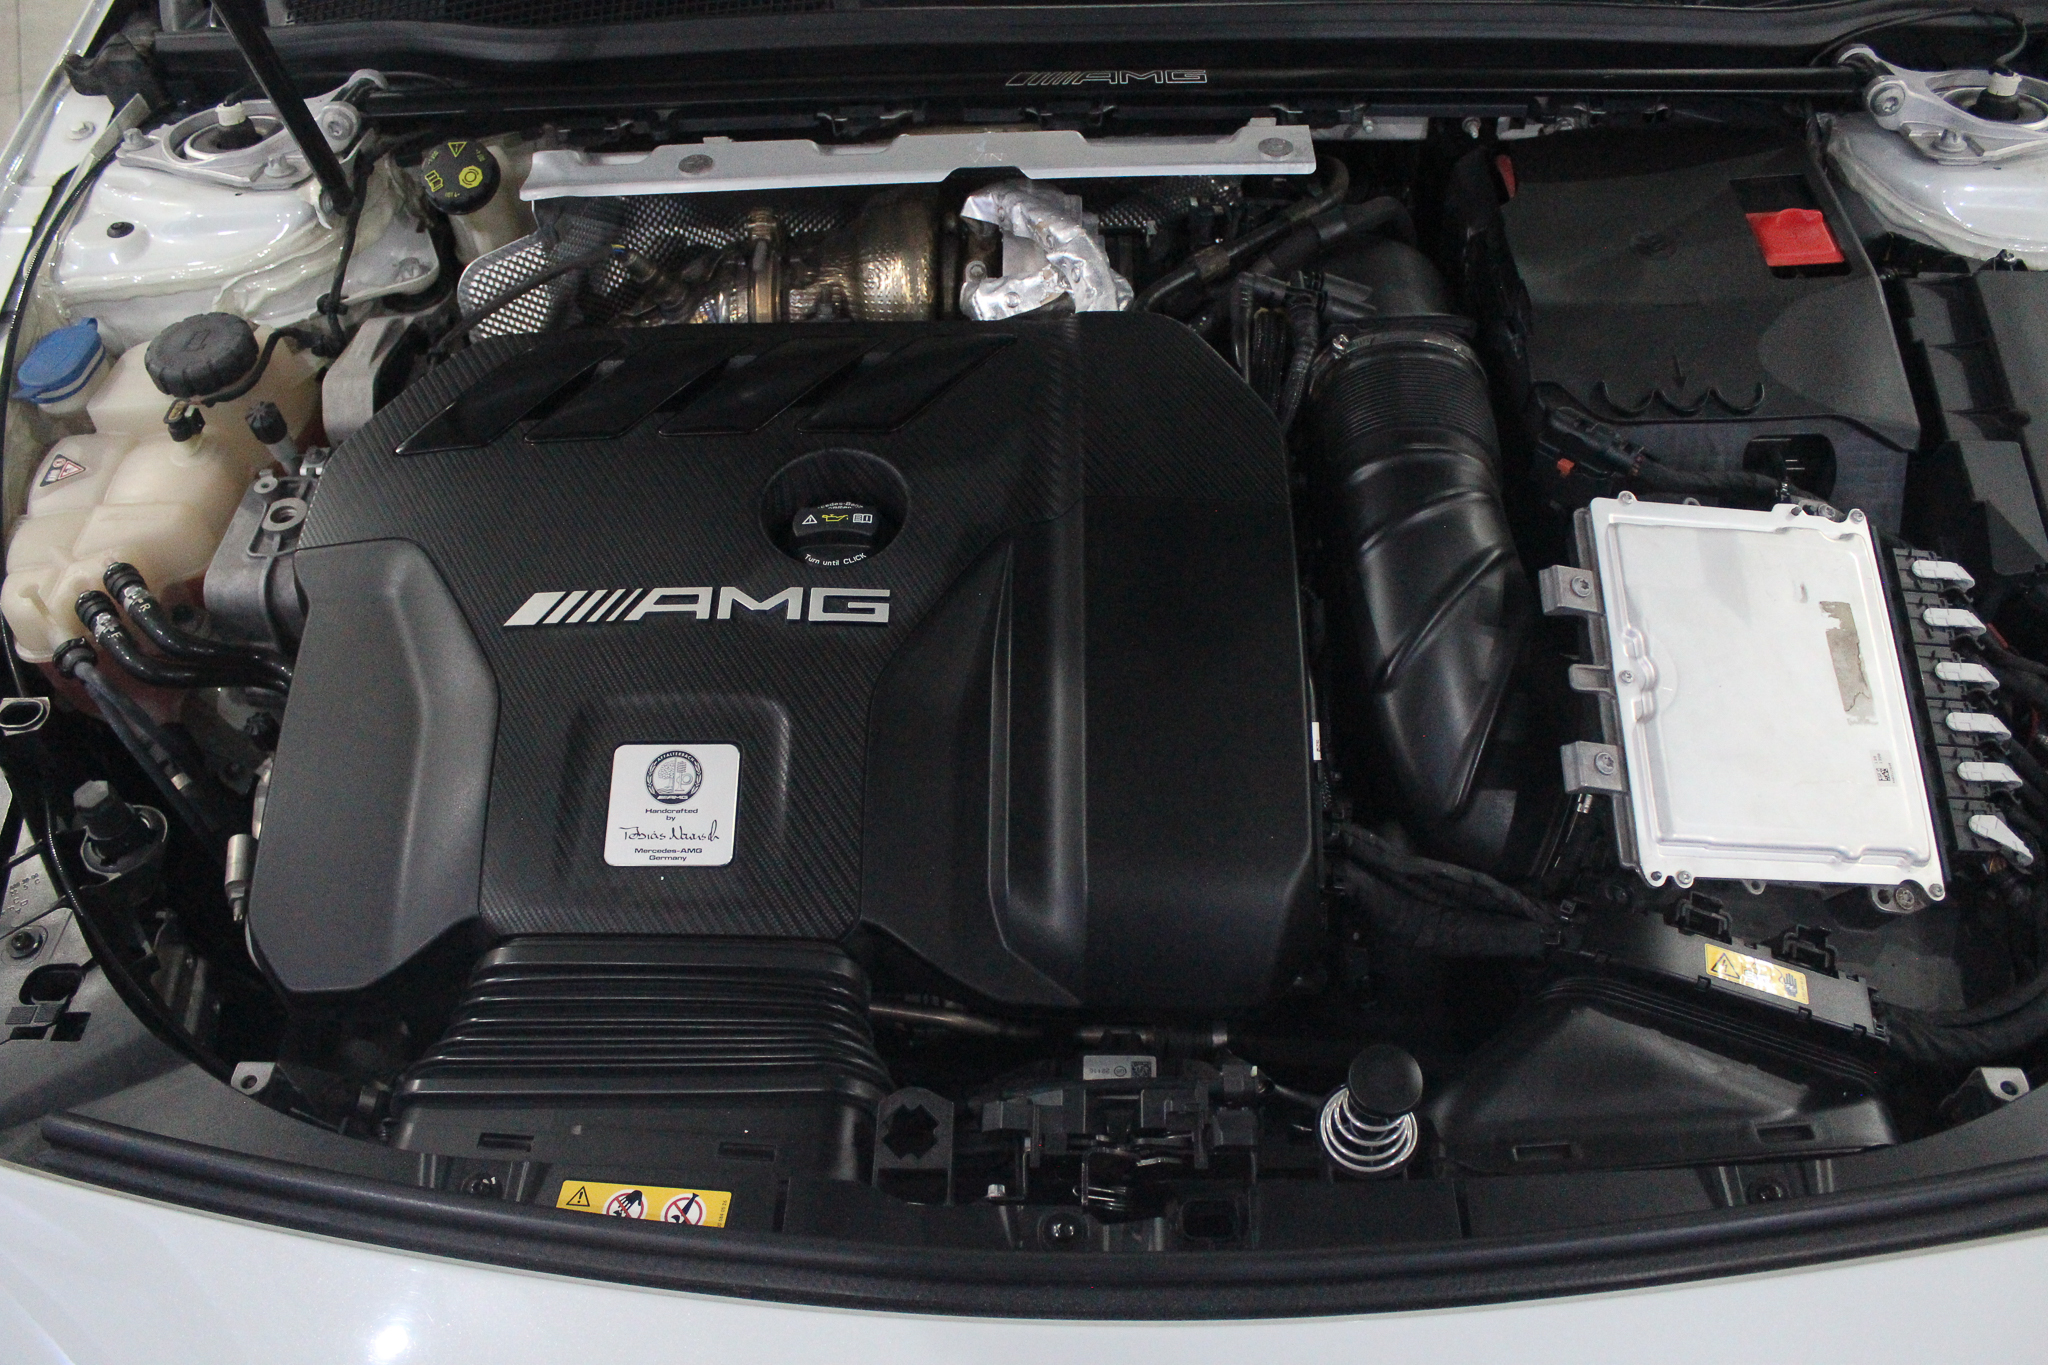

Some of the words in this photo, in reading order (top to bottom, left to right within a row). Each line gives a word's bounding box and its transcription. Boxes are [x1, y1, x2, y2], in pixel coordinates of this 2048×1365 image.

[1071, 70, 1207, 85] AMG
[804, 553, 820, 565] Turn
[843, 552, 867, 565] CLICK
[623, 586, 890, 623] AMG
[619, 826, 666, 841] Tobias
